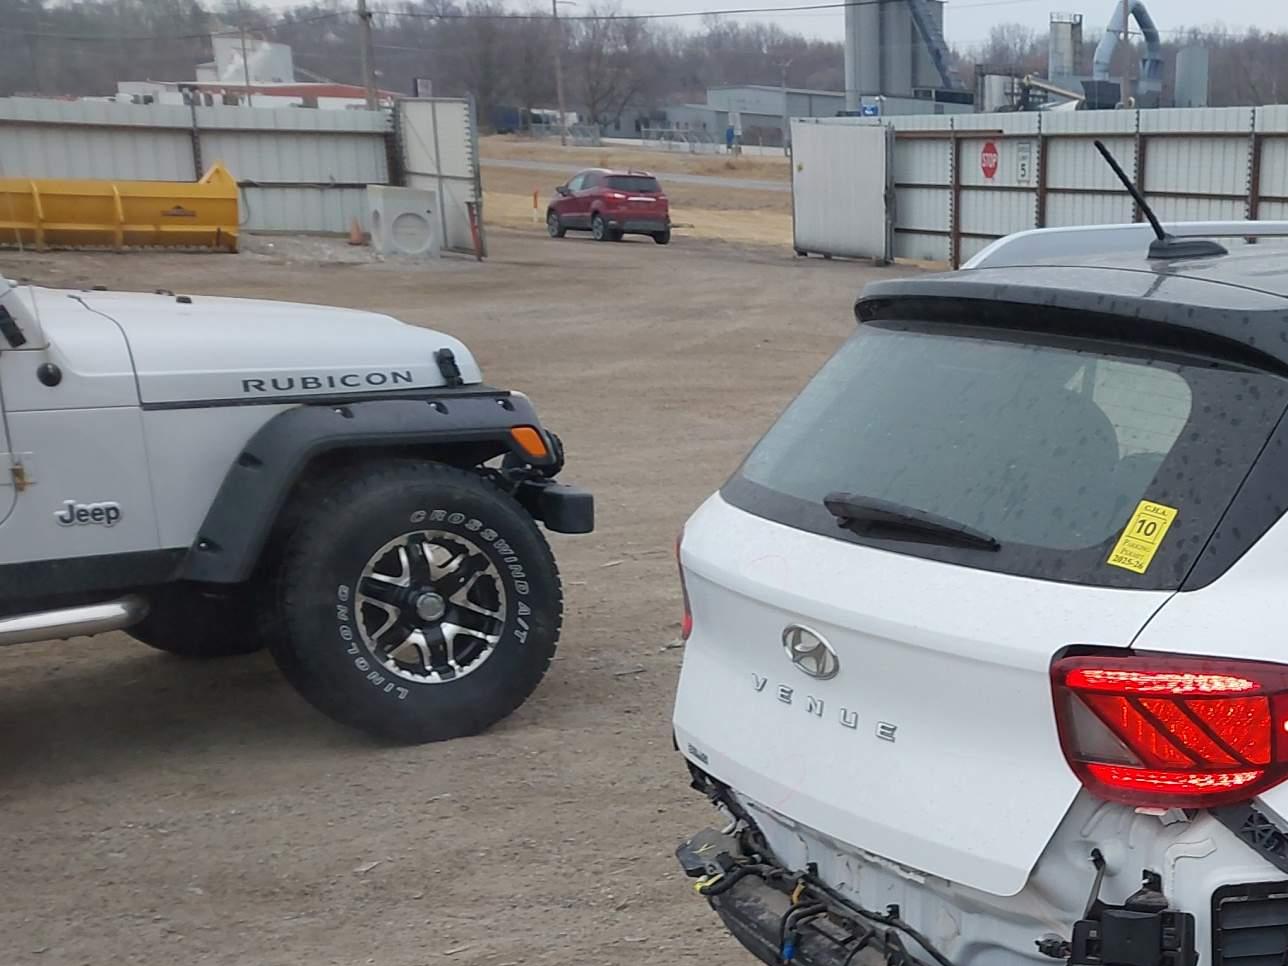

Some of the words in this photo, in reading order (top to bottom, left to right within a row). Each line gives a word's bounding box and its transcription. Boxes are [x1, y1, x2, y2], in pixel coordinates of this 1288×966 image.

[982, 152, 998, 169] STOP
[1020, 163, 1026, 178] 5
[242, 370, 413, 393] RUBICON
[55, 500, 123, 527] Jeep
[1136, 519, 1157, 537] 10
[410, 509, 530, 595] CROSSWIND
[514, 601, 531, 643] A/T
[337, 585, 409, 700] LINGLONG
[751, 673, 897, 742] VENUE
